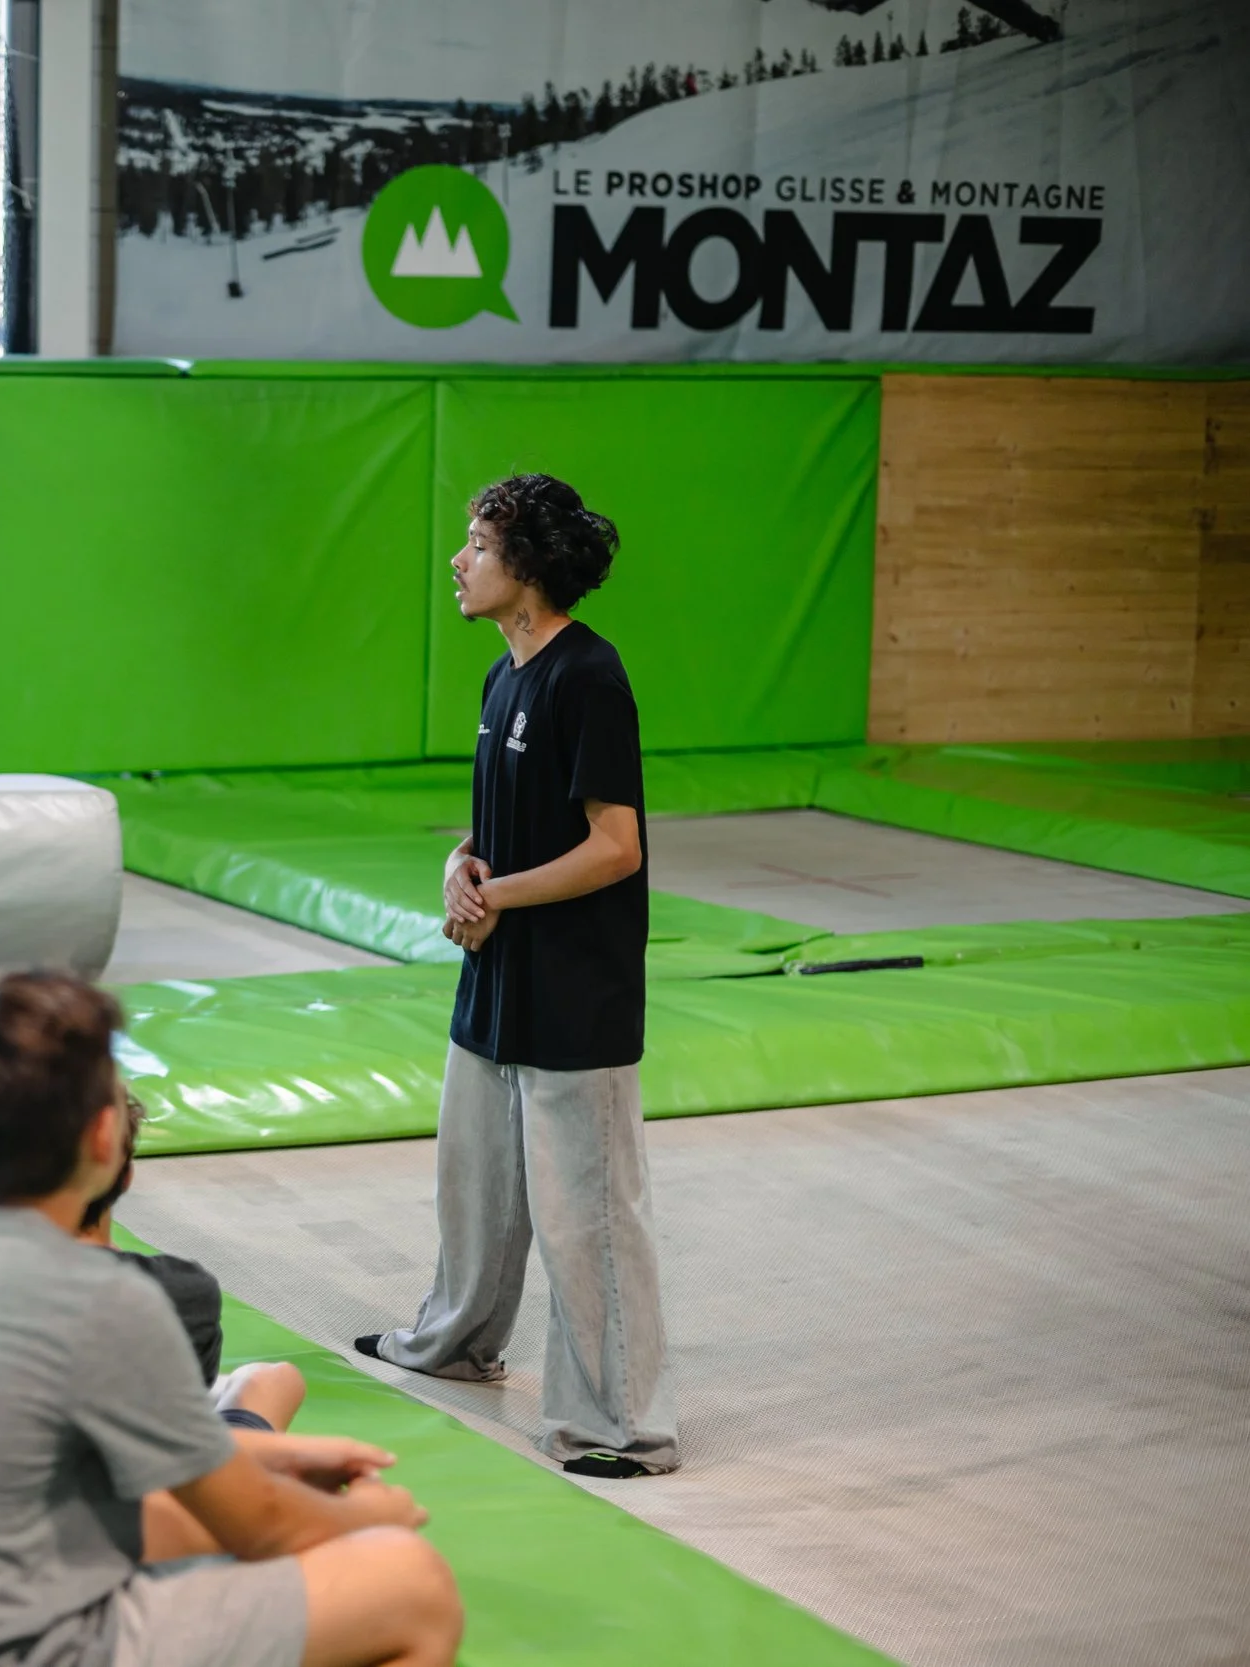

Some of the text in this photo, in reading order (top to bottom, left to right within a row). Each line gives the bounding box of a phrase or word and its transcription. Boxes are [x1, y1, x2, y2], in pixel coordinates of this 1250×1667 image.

[553, 169, 1106, 211] LE PROSHOP GLISSE & MONTAGNE
[548, 203, 1103, 334] MONTAZ
